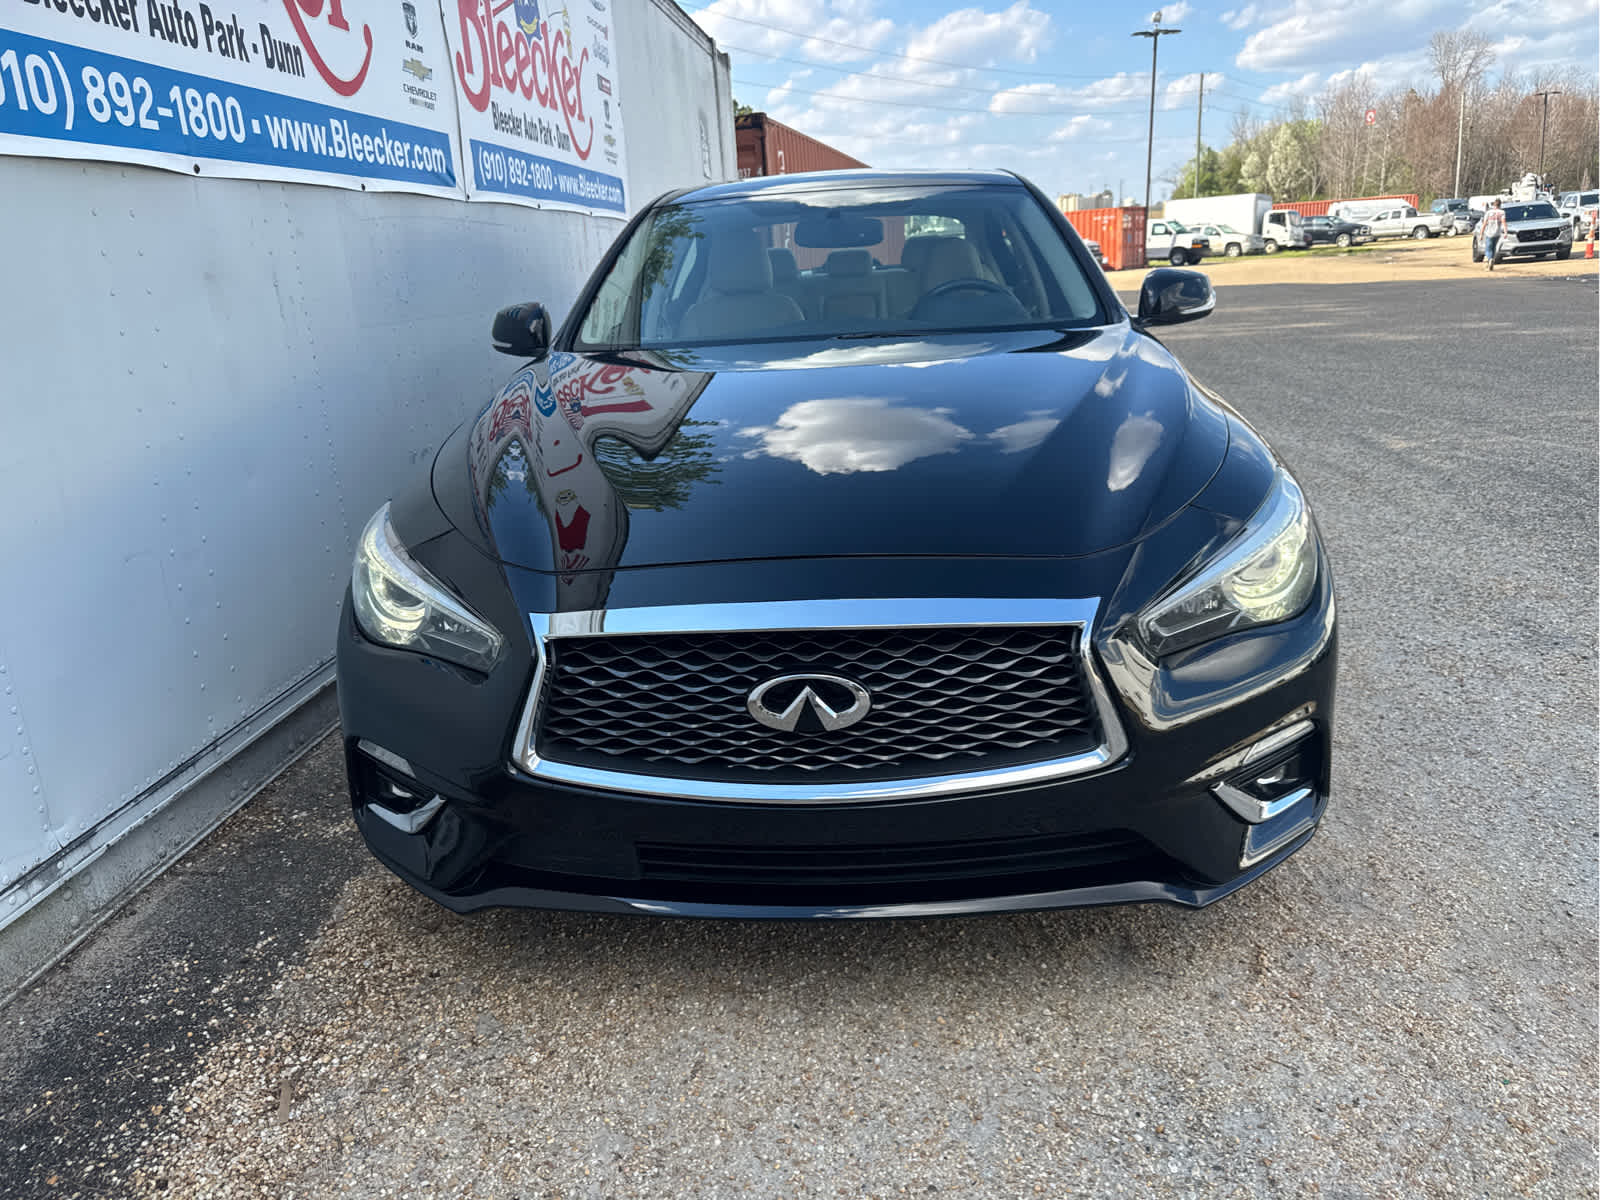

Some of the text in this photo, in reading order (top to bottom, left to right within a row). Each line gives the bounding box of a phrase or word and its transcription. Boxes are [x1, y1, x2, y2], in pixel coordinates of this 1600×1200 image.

[147, 0, 199, 50] Auto
[199, 2, 250, 63] Park
[259, 22, 305, 78] Dunn
[404, 40, 424, 53] RAM
[0, 48, 447, 174] 10) 892-1800 www.Bleecker.com
[402, 83, 437, 102] CHEVROLET
[491, 100, 570, 152] Bleecker Auto Park Dunn
[478, 146, 623, 205] (910) 892-1800 www.Bleecker.com
